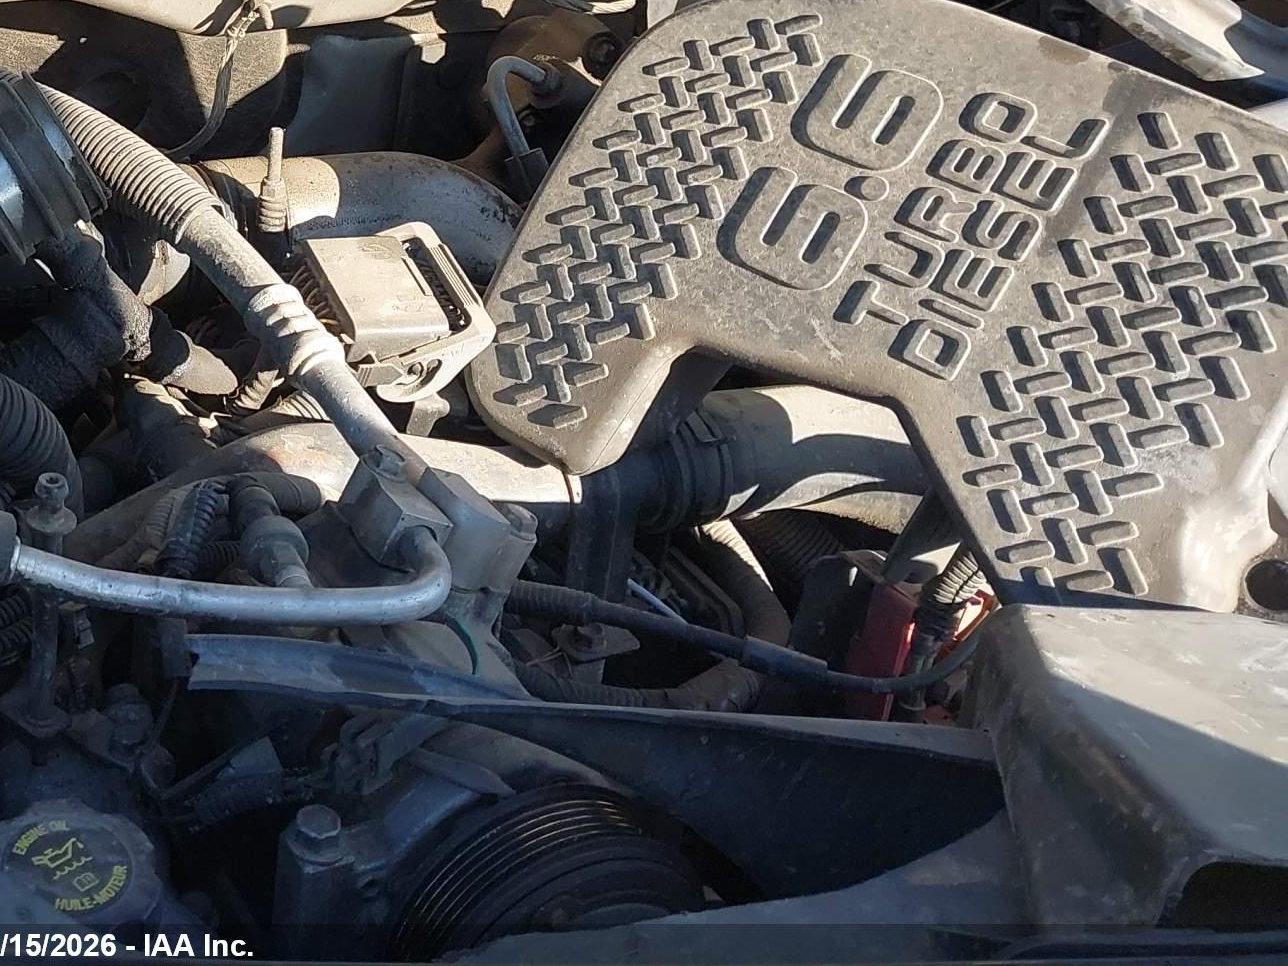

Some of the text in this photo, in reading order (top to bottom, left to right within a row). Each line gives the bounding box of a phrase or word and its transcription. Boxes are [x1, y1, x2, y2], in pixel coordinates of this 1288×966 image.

[715, 52, 944, 291] 6.6
[832, 91, 1038, 325] TURBO
[887, 118, 1110, 382] DIESEL
[13, 819, 71, 855] ENGINE OIL
[55, 865, 128, 911] HUILE-MOTEUR
